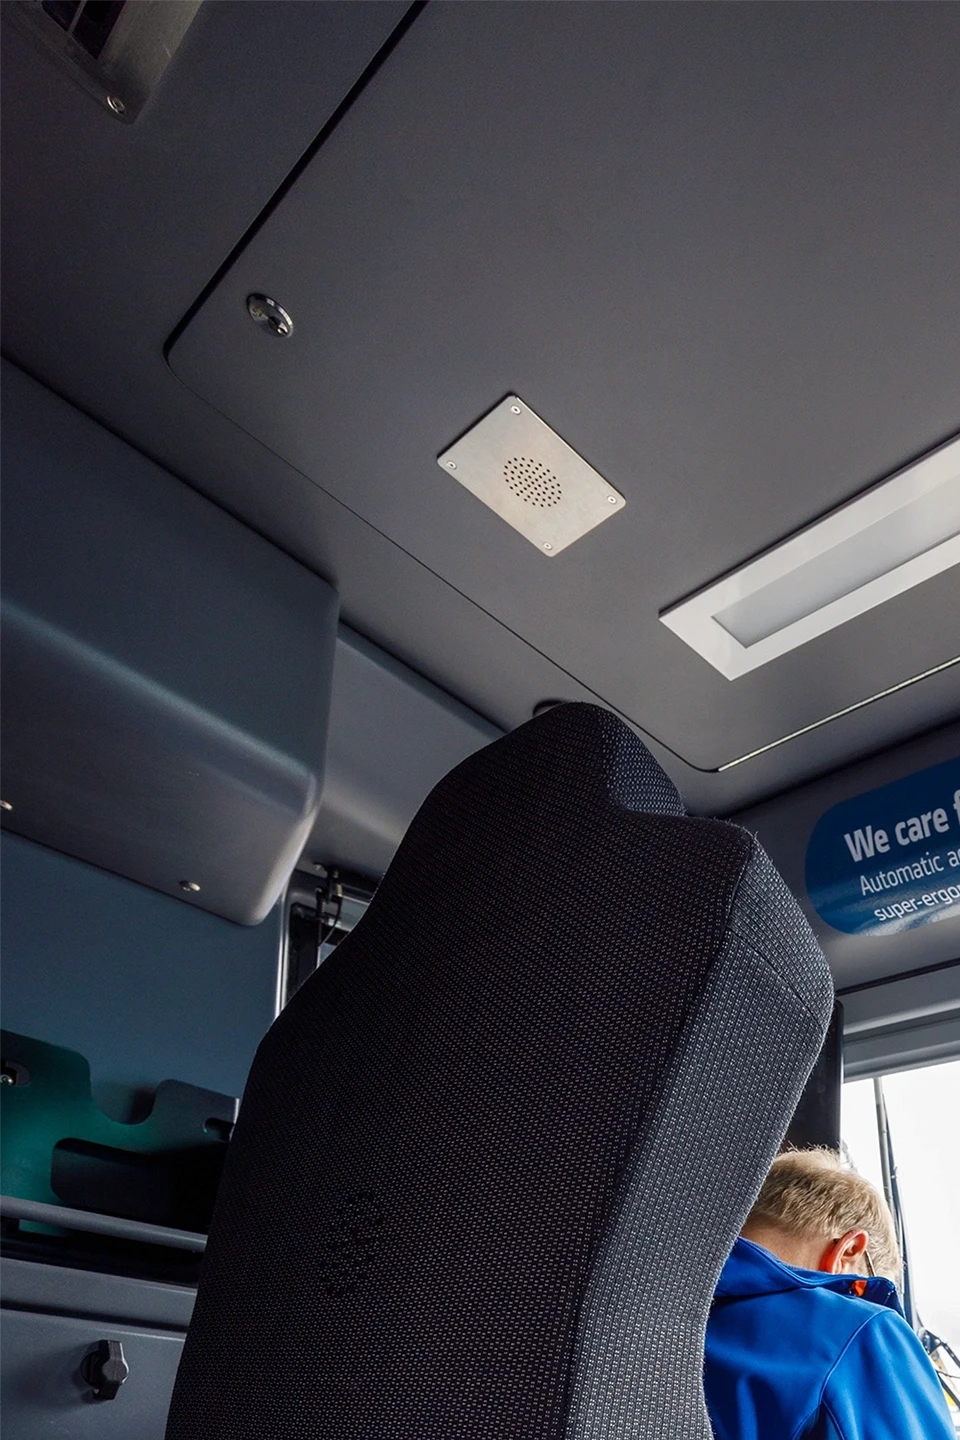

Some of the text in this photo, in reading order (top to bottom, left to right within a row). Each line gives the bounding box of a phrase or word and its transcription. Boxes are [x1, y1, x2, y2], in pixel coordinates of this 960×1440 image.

[844, 825, 891, 862] We
[895, 808, 949, 846] care
[859, 852, 944, 896] Automatic
